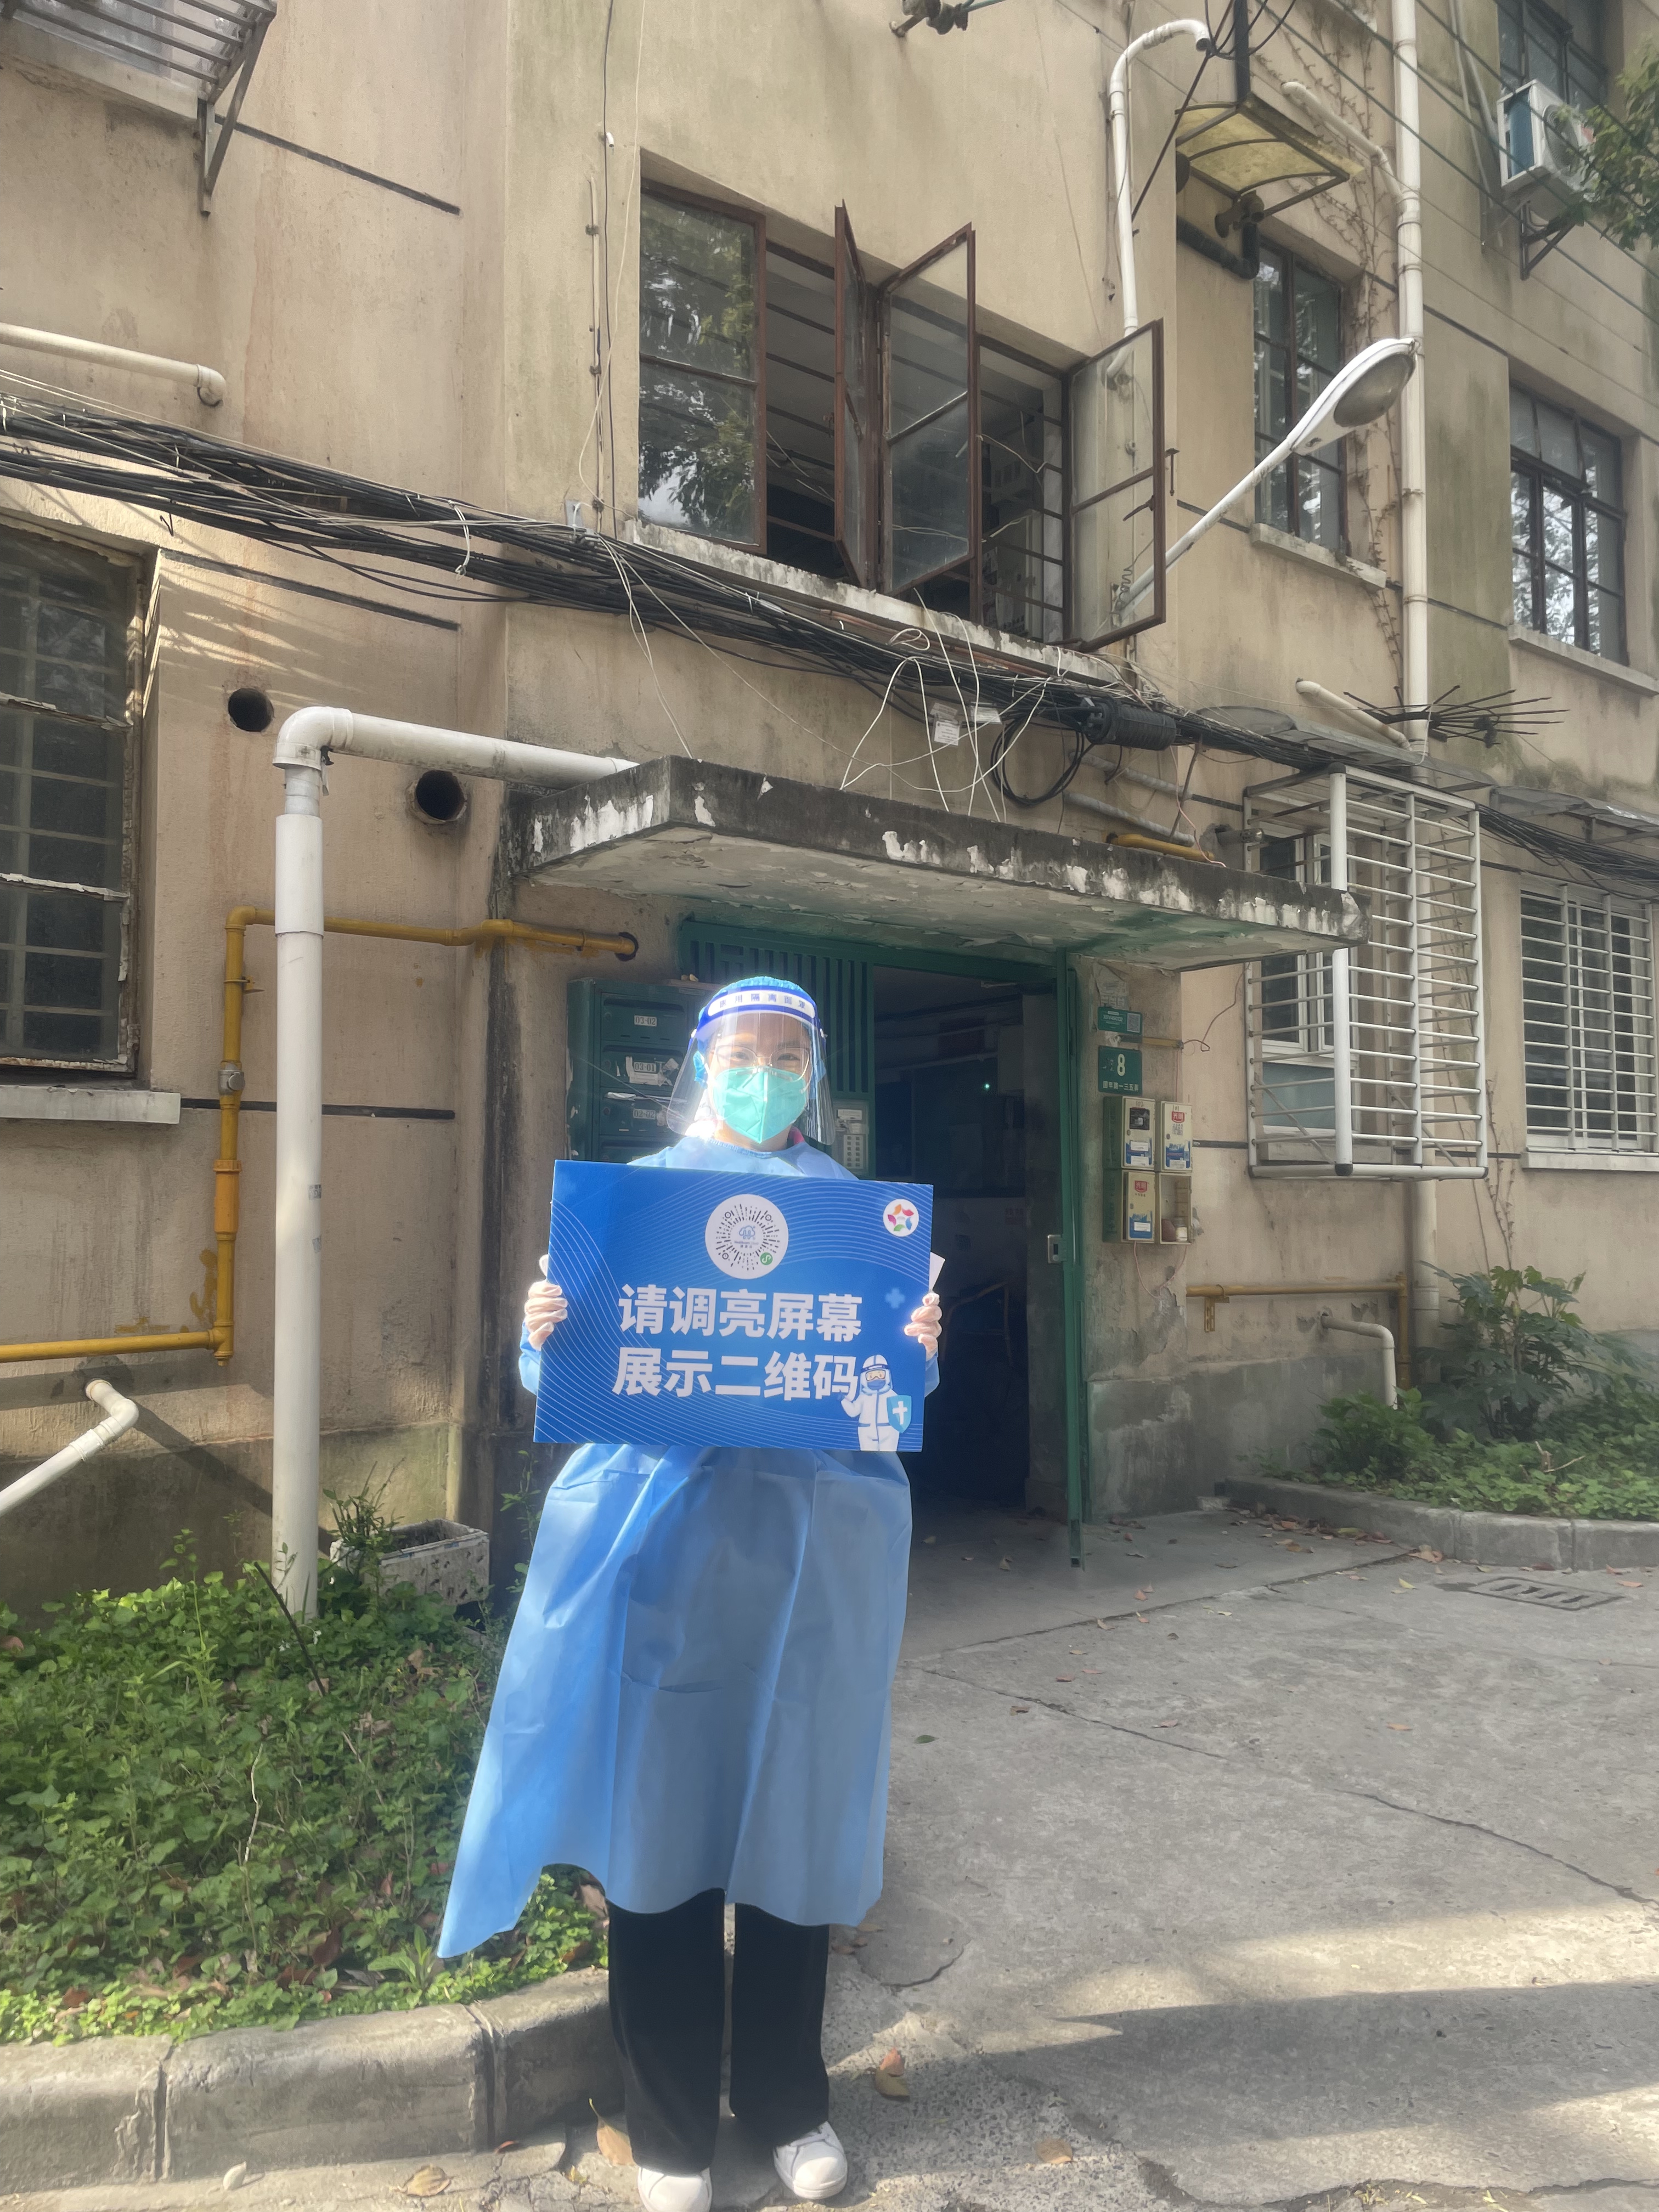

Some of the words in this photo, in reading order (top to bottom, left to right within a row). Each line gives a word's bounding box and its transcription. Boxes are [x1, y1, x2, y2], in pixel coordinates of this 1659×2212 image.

[635, 1017, 656, 1025] 03-02
[634, 1063, 656, 1072] 03-01
[1117, 1053, 1126, 1076] 8
[634, 1109, 655, 1118] 02-02
[618, 1283, 862, 1342] 请调亮屏幕
[612, 1346, 859, 1402] 展示二维码
